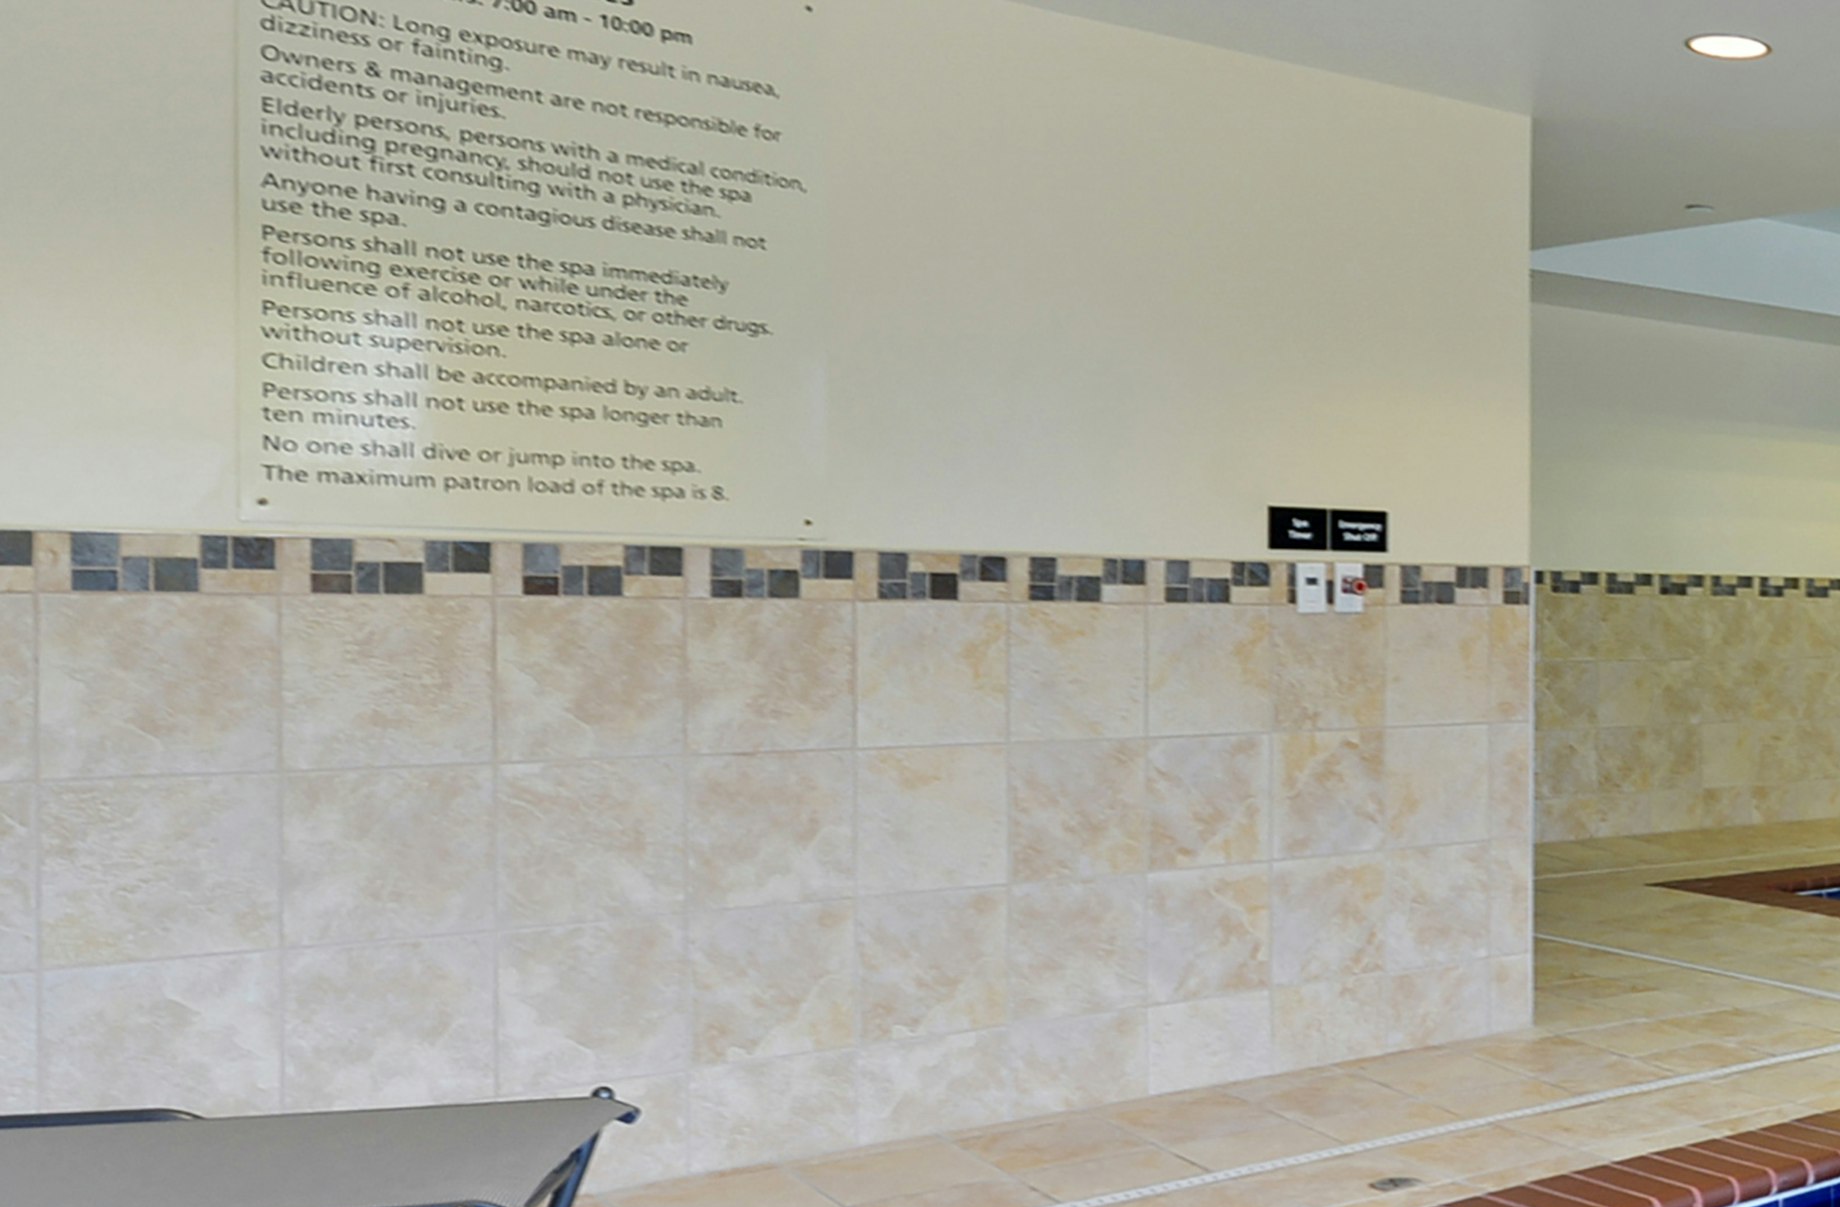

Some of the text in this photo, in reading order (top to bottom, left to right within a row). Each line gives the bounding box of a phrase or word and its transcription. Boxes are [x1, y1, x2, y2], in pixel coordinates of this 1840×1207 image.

[259, 14, 510, 74] dizziness or fainting.
[260, 0, 780, 99] CAUTION: Long exposure may result in nausea,
[542, 5, 578, 24] am
[599, 13, 655, 38] 10:00
[659, 28, 693, 46] pm
[259, 69, 506, 120] accidents or injuries.
[260, 44, 782, 142] Owners & management are not responsible for
[261, 95, 807, 194] Elderly persons, persons with a medical condition,
[261, 118, 752, 204] including pregnancy, should not use the spa
[260, 143, 721, 219] without first consulting with a physician.
[260, 172, 767, 251] Anyone having a contagious disease shall not
[261, 197, 407, 228] use the spa.
[261, 223, 729, 295] Persons shall not use the spa immediately
[261, 245, 690, 308] following exercise or while under the
[261, 268, 773, 338] influence of alcohol, narcotics, or other drugs.
[261, 299, 689, 353] Persons shall not use the spa alone or
[260, 323, 507, 359] without supervision.
[261, 351, 743, 404] Children shall be accompanied by an adult.
[262, 381, 723, 428] Persons shall not use the spa longer than
[261, 406, 416, 430] ten minutes.
[260, 463, 729, 502] The maximum patron load of the spa is 8.
[262, 434, 701, 476] No one shall dive or jump into the spa.
